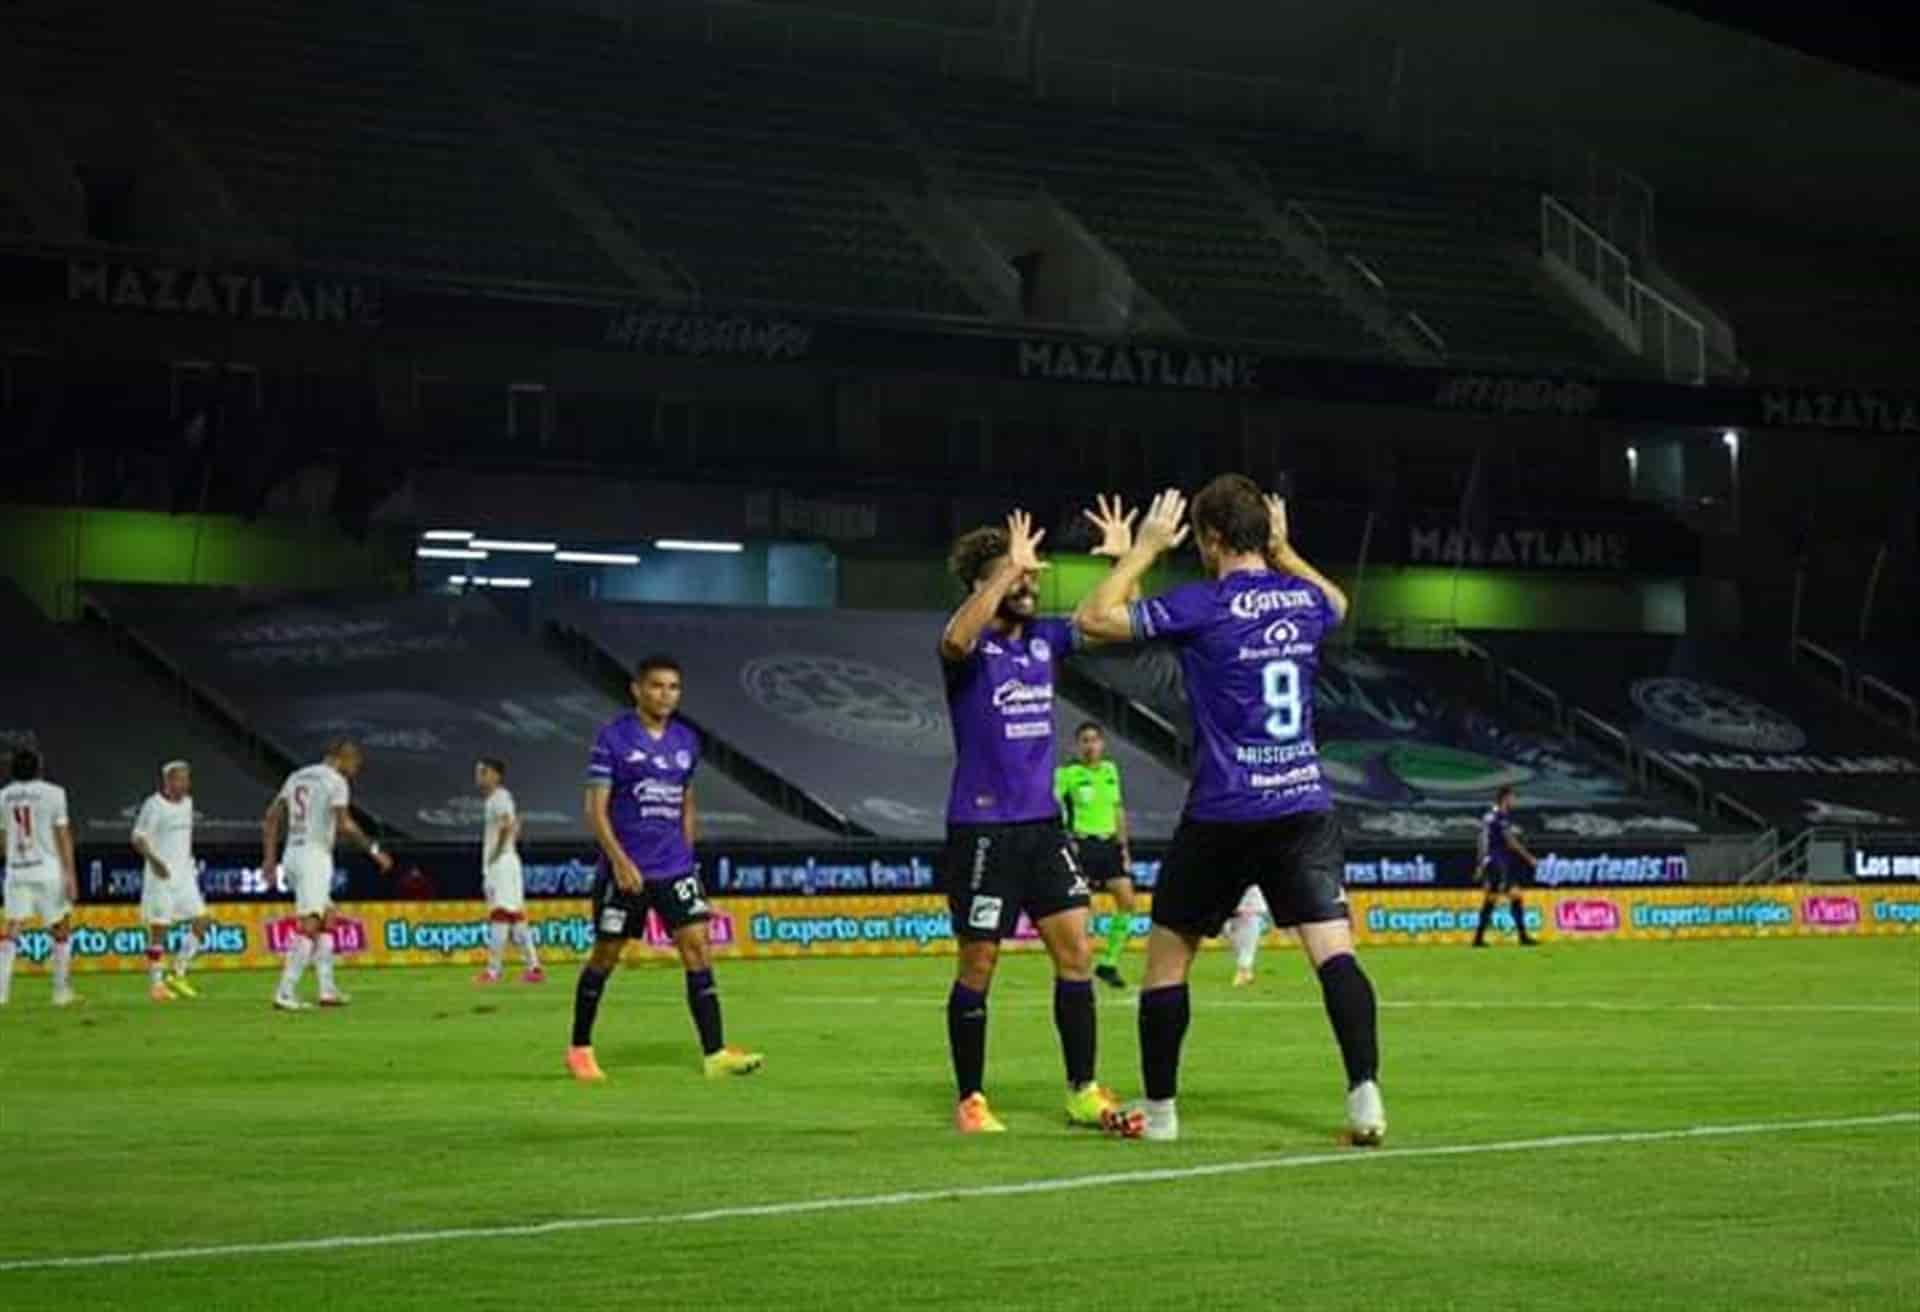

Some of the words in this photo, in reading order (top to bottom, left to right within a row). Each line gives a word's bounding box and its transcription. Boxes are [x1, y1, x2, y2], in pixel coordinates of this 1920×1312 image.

[1262, 659, 1302, 741] 9
[1855, 851, 1891, 876] Los
[113, 930, 147, 952] en
[387, 921, 408, 948] El
[414, 922, 493, 952] expert
[893, 911, 953, 943] Frijol
